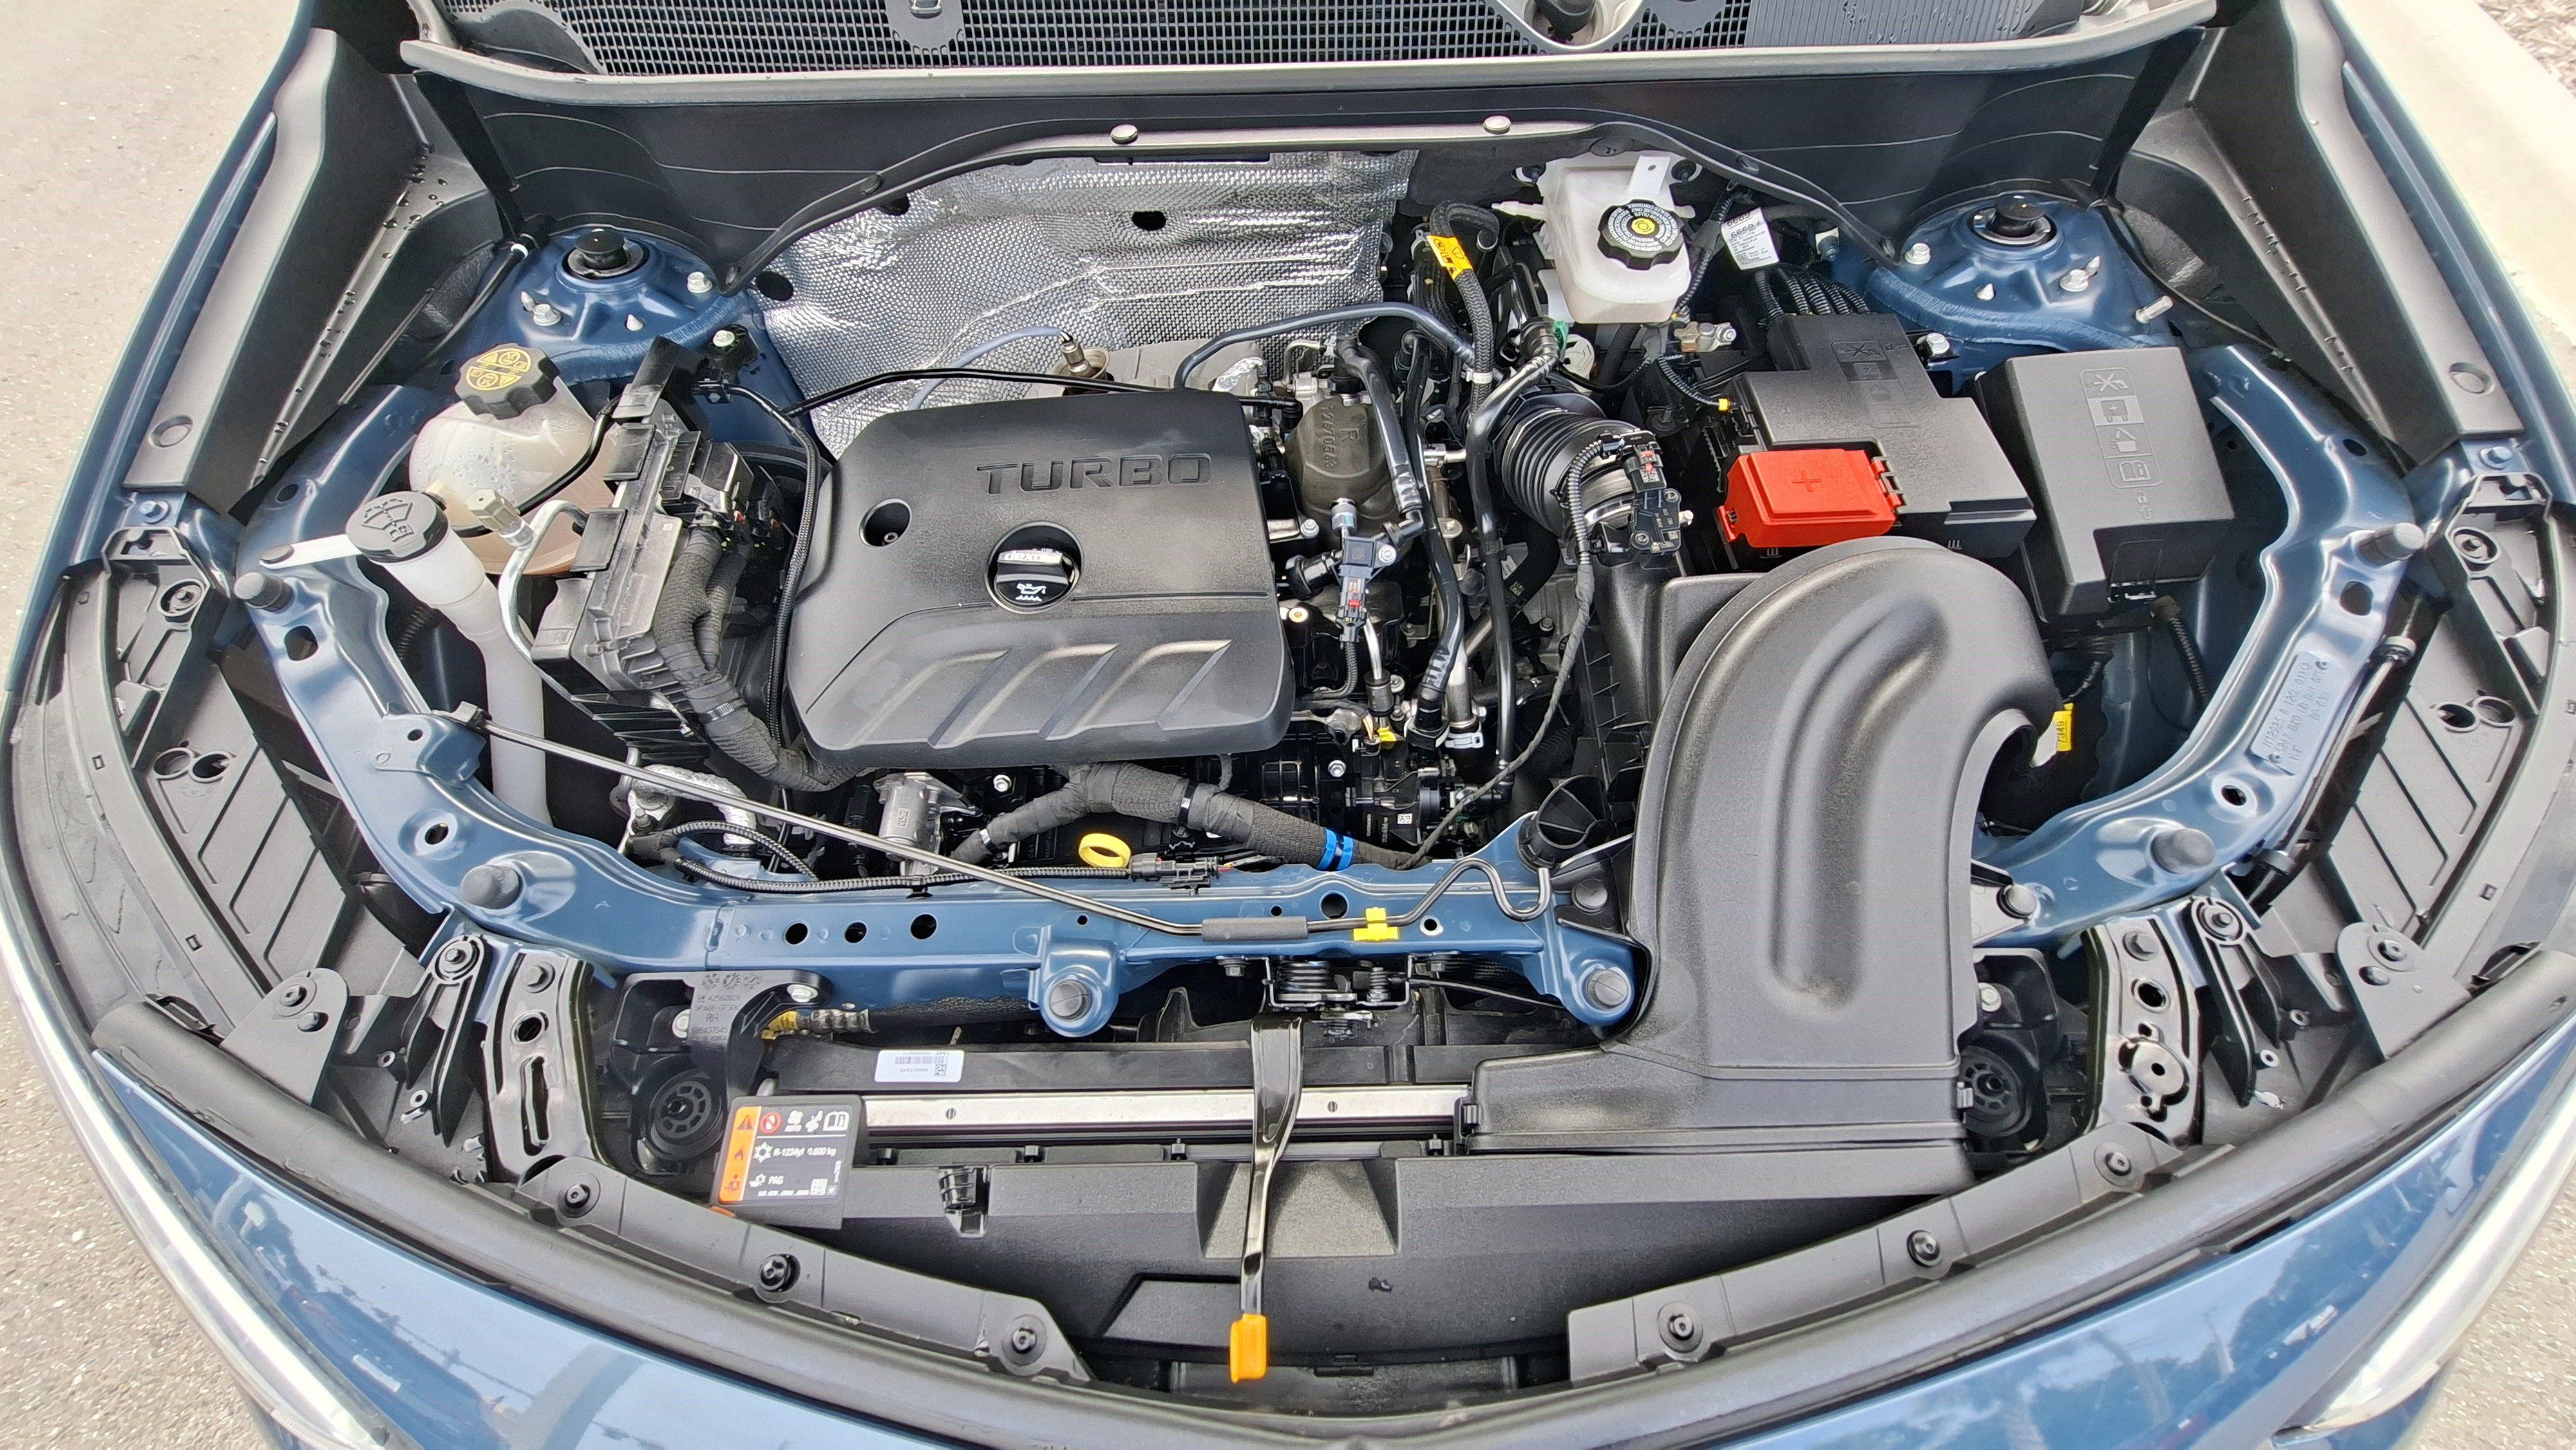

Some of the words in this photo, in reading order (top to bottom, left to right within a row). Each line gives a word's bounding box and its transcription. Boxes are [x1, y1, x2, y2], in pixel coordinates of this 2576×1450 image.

[1341, 428, 1359, 442] R
[976, 453, 1211, 494] TURBO
[706, 1012, 719, 1022] RH
[768, 1176, 784, 1185] PAG
